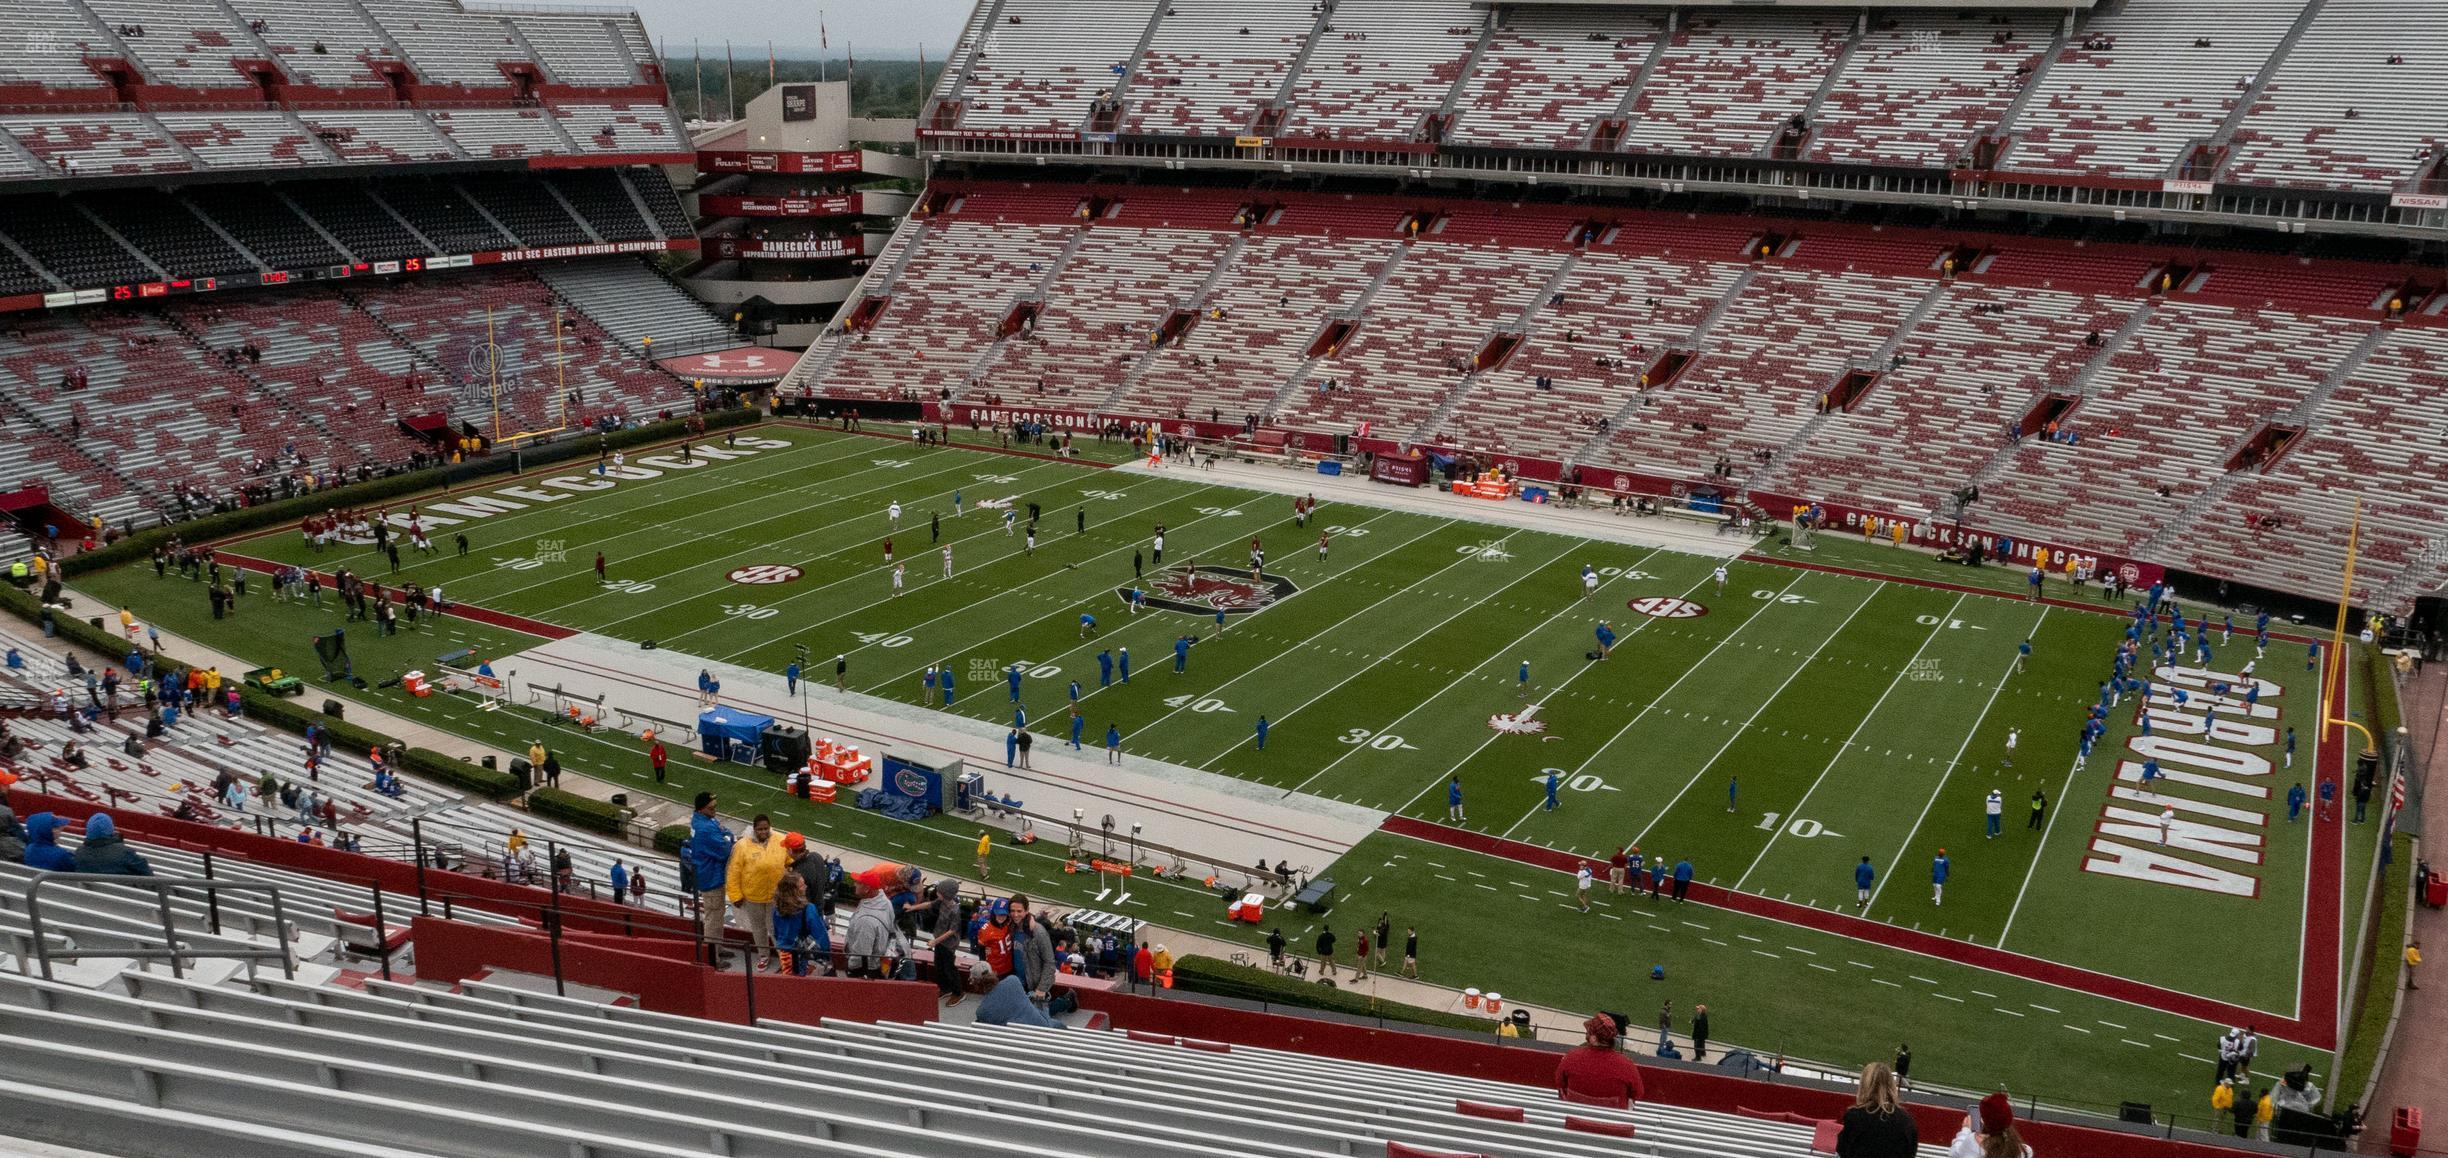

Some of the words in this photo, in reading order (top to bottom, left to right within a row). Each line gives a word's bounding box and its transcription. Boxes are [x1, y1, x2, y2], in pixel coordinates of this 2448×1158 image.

[2400, 198, 2440, 206] NISSAN
[501, 251, 523, 262] 2010
[525, 250, 541, 259] SEC
[543, 247, 577, 258] EASTERN
[578, 244, 615, 255] DIVISION
[618, 241, 667, 251] CHAMPIONS
[762, 241, 817, 252] GAMECOCK
[821, 240, 843, 251] CLUB
[743, 251, 778, 259] SUPPORTING
[806, 250, 831, 258] ATHLETES
[406, 258, 420, 271] 25
[114, 286, 132, 299] 25
[460, 378, 517, 399] Allstate
[1323, 525, 1370, 537] 50
[1598, 566, 1648, 580] 30
[602, 579, 656, 594] 20
[1751, 589, 1806, 604] 20
[724, 604, 779, 619] 30
[1632, 597, 1704, 618] SEC
[1916, 615, 1965, 629] 10
[858, 632, 914, 648] 40
[1001, 660, 1062, 679] 50
[1163, 694, 1225, 713] 40
[1338, 728, 1404, 750] 30
[813, 763, 820, 775] G
[835, 769, 845, 780] G
[1530, 768, 1604, 792] 20
[2079, 664, 2286, 899] CAROLINA
[1754, 811, 1823, 838] 10
[1631, 860, 1640, 868] 15
[998, 933, 1012, 955] 15
[1105, 942, 1114, 951] 15
